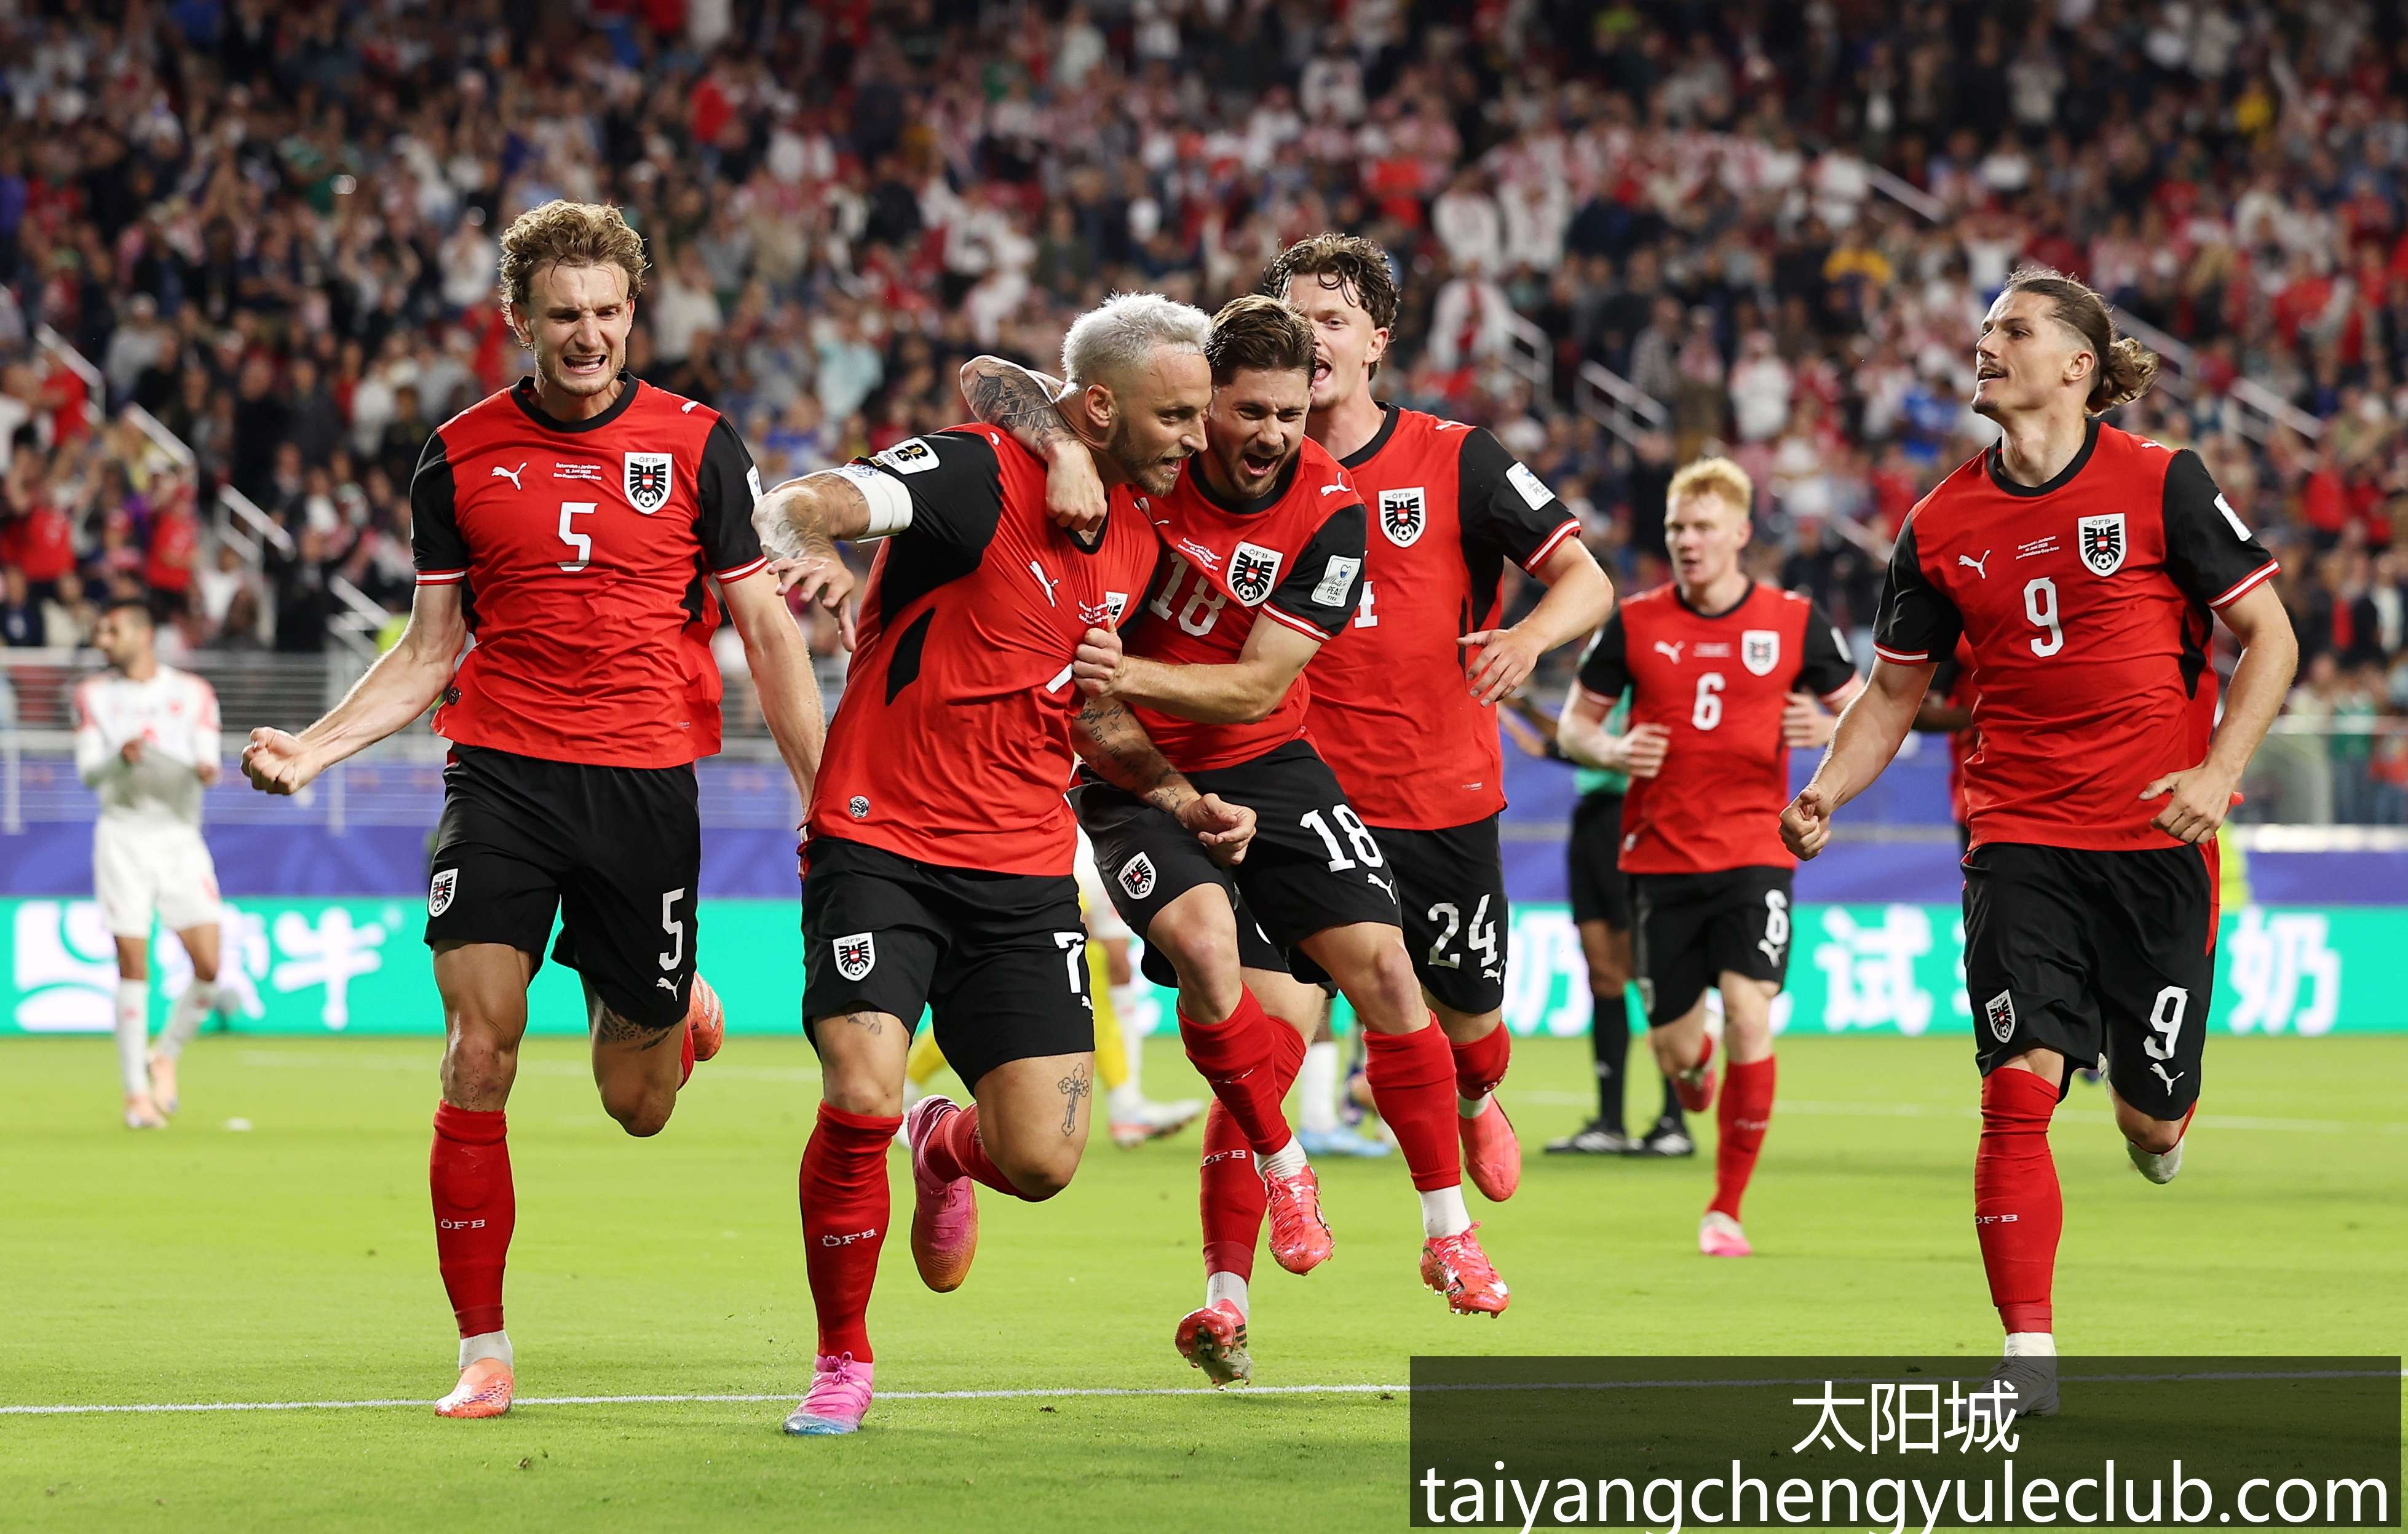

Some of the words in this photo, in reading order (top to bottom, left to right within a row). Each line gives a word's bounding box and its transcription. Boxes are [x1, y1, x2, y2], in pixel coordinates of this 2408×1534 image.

[557, 501, 598, 572] 5
[1149, 552, 1228, 637] 18
[2023, 576, 2064, 658] 9
[1692, 672, 1725, 731] 6
[1299, 803, 1384, 872] 18
[659, 888, 686, 971] 5
[1427, 893, 1500, 970] 24
[1764, 889, 1790, 945] 6
[1053, 931, 1086, 994] 7
[2143, 985, 2189, 1060] 9
[440, 1218, 486, 1230] ÖFB
[822, 1228, 877, 1247] ÖFB
